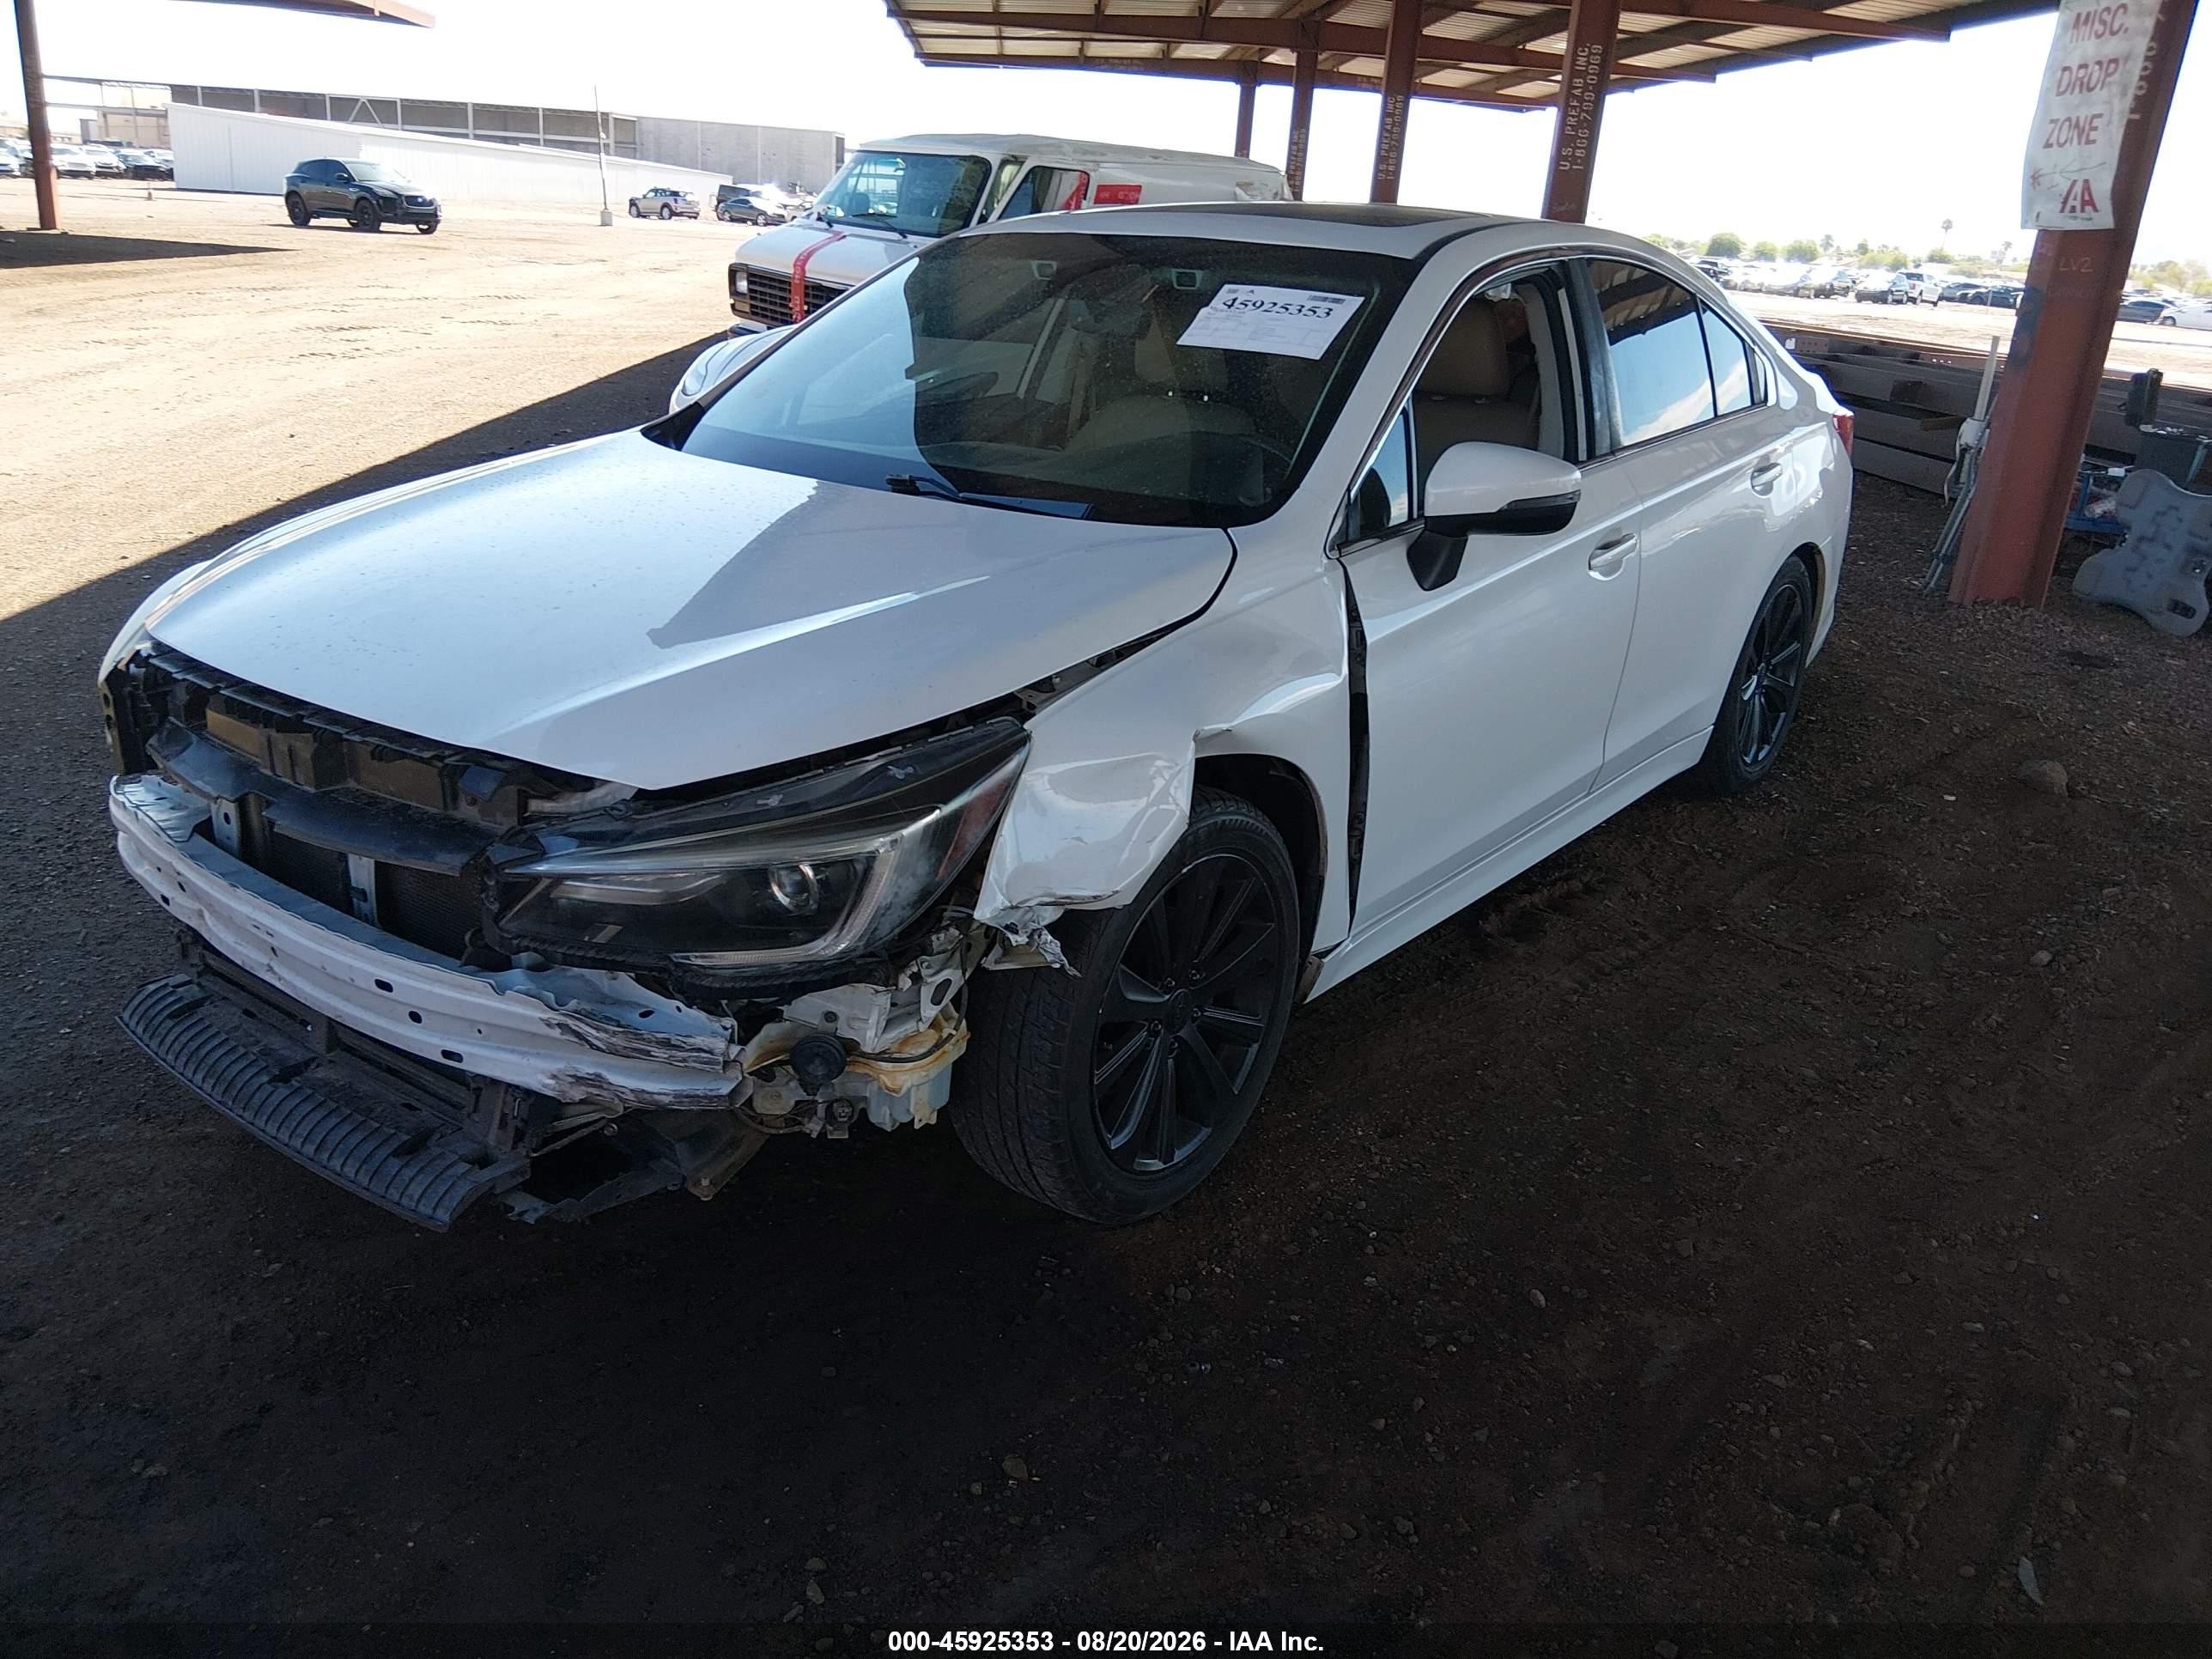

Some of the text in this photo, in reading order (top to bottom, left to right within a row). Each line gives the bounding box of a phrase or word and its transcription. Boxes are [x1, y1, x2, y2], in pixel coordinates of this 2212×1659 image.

[2069, 3, 2130, 44] MISC.
[1574, 43, 1590, 70] INC.
[2055, 58, 2120, 97] DROP
[1565, 78, 1584, 135] PREFAB
[2042, 112, 2104, 149] ZONE
[1222, 296, 1334, 319] 45925353
